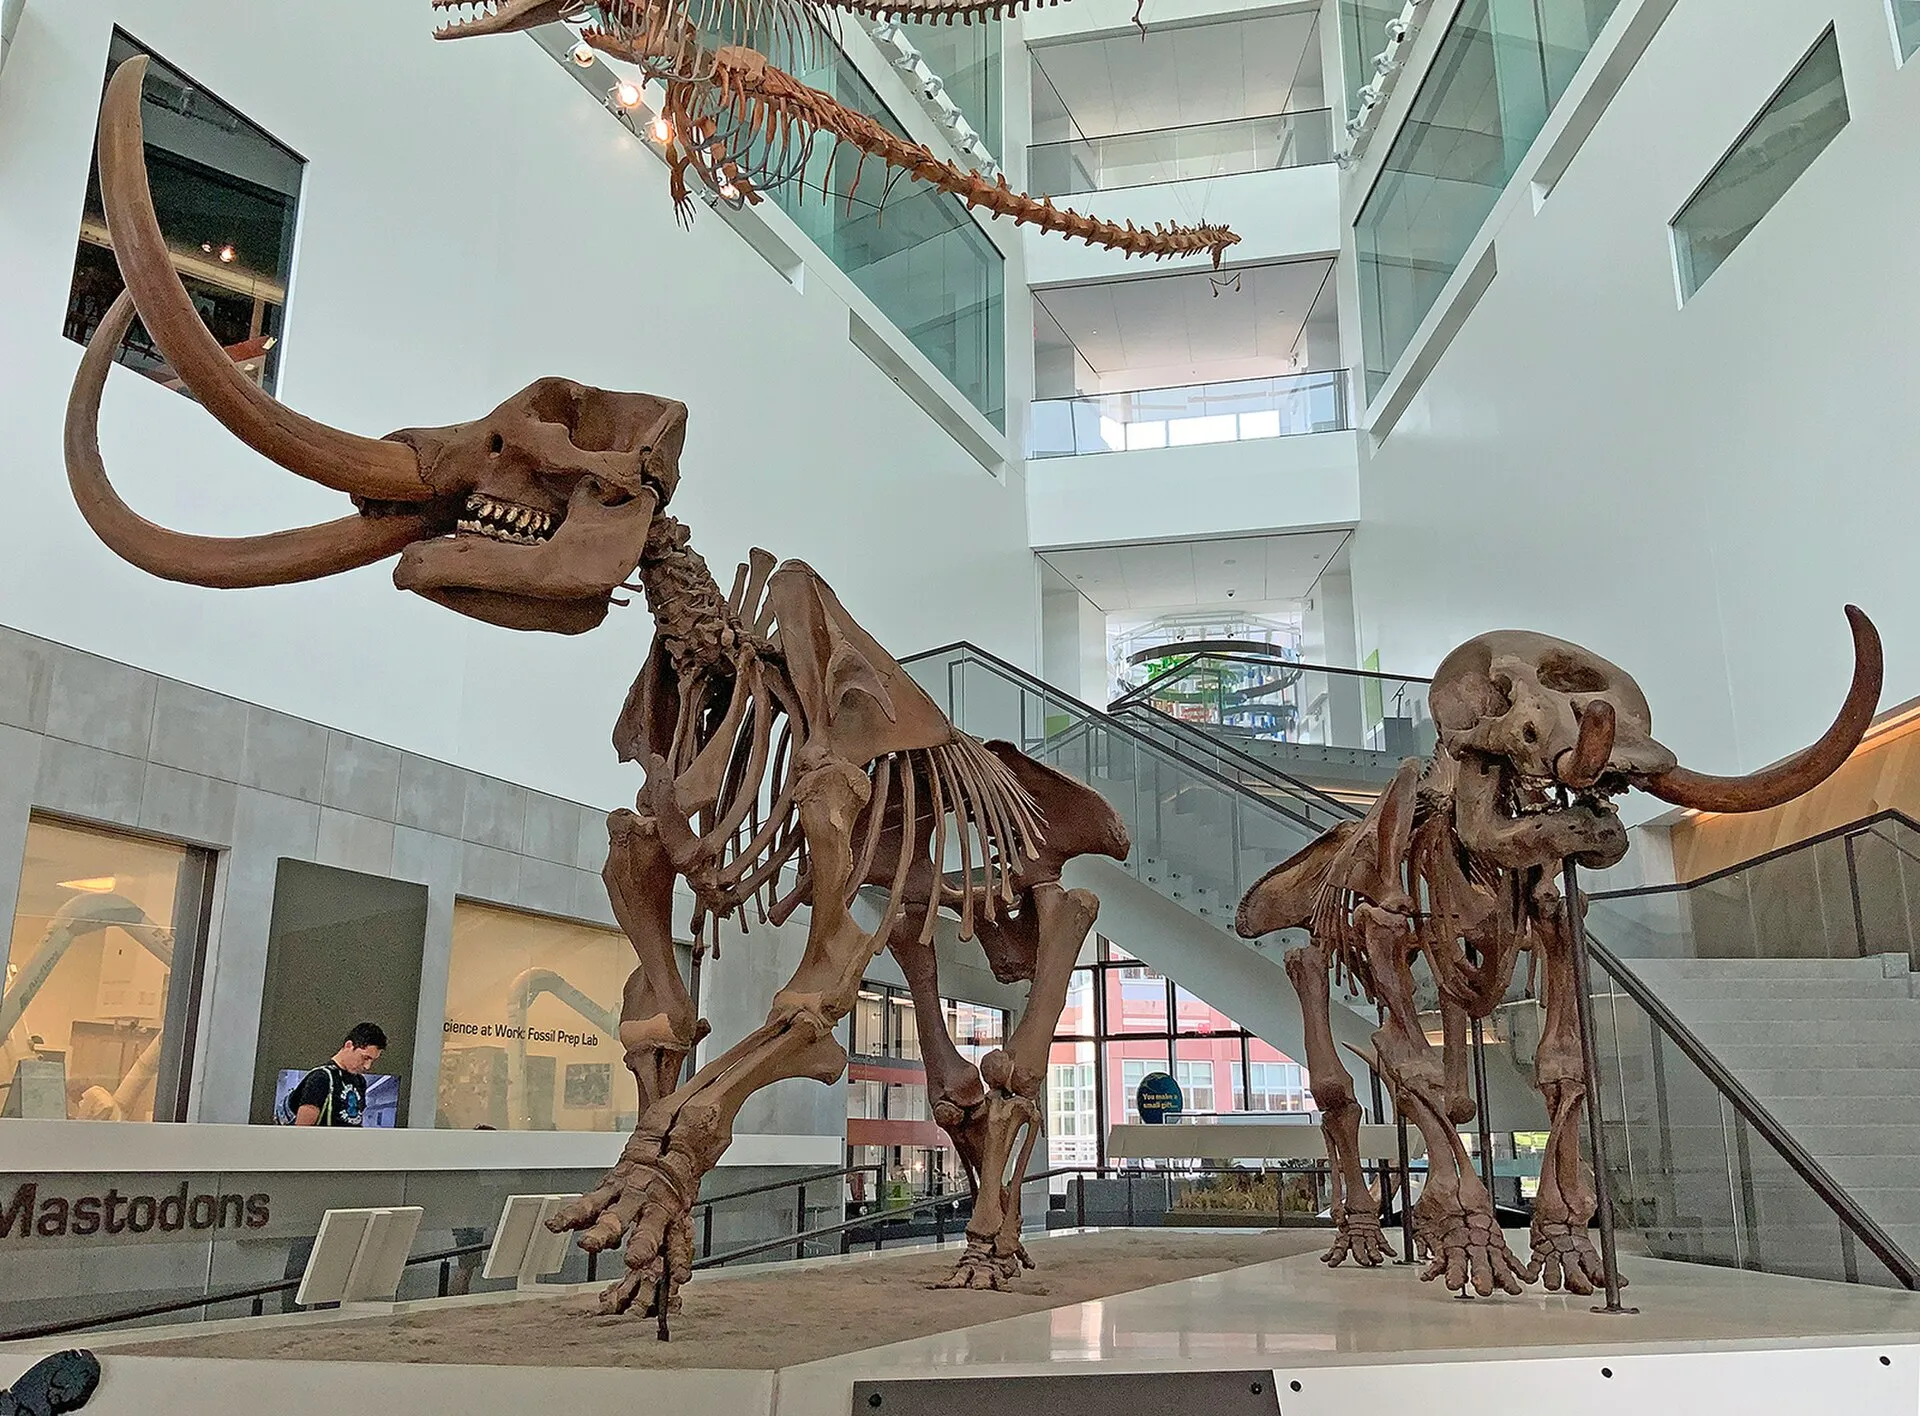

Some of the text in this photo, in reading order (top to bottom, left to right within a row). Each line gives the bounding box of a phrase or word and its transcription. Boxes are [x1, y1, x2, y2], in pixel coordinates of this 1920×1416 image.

[443, 1019, 599, 1047] cience at Work: Fossil Prep Lab
